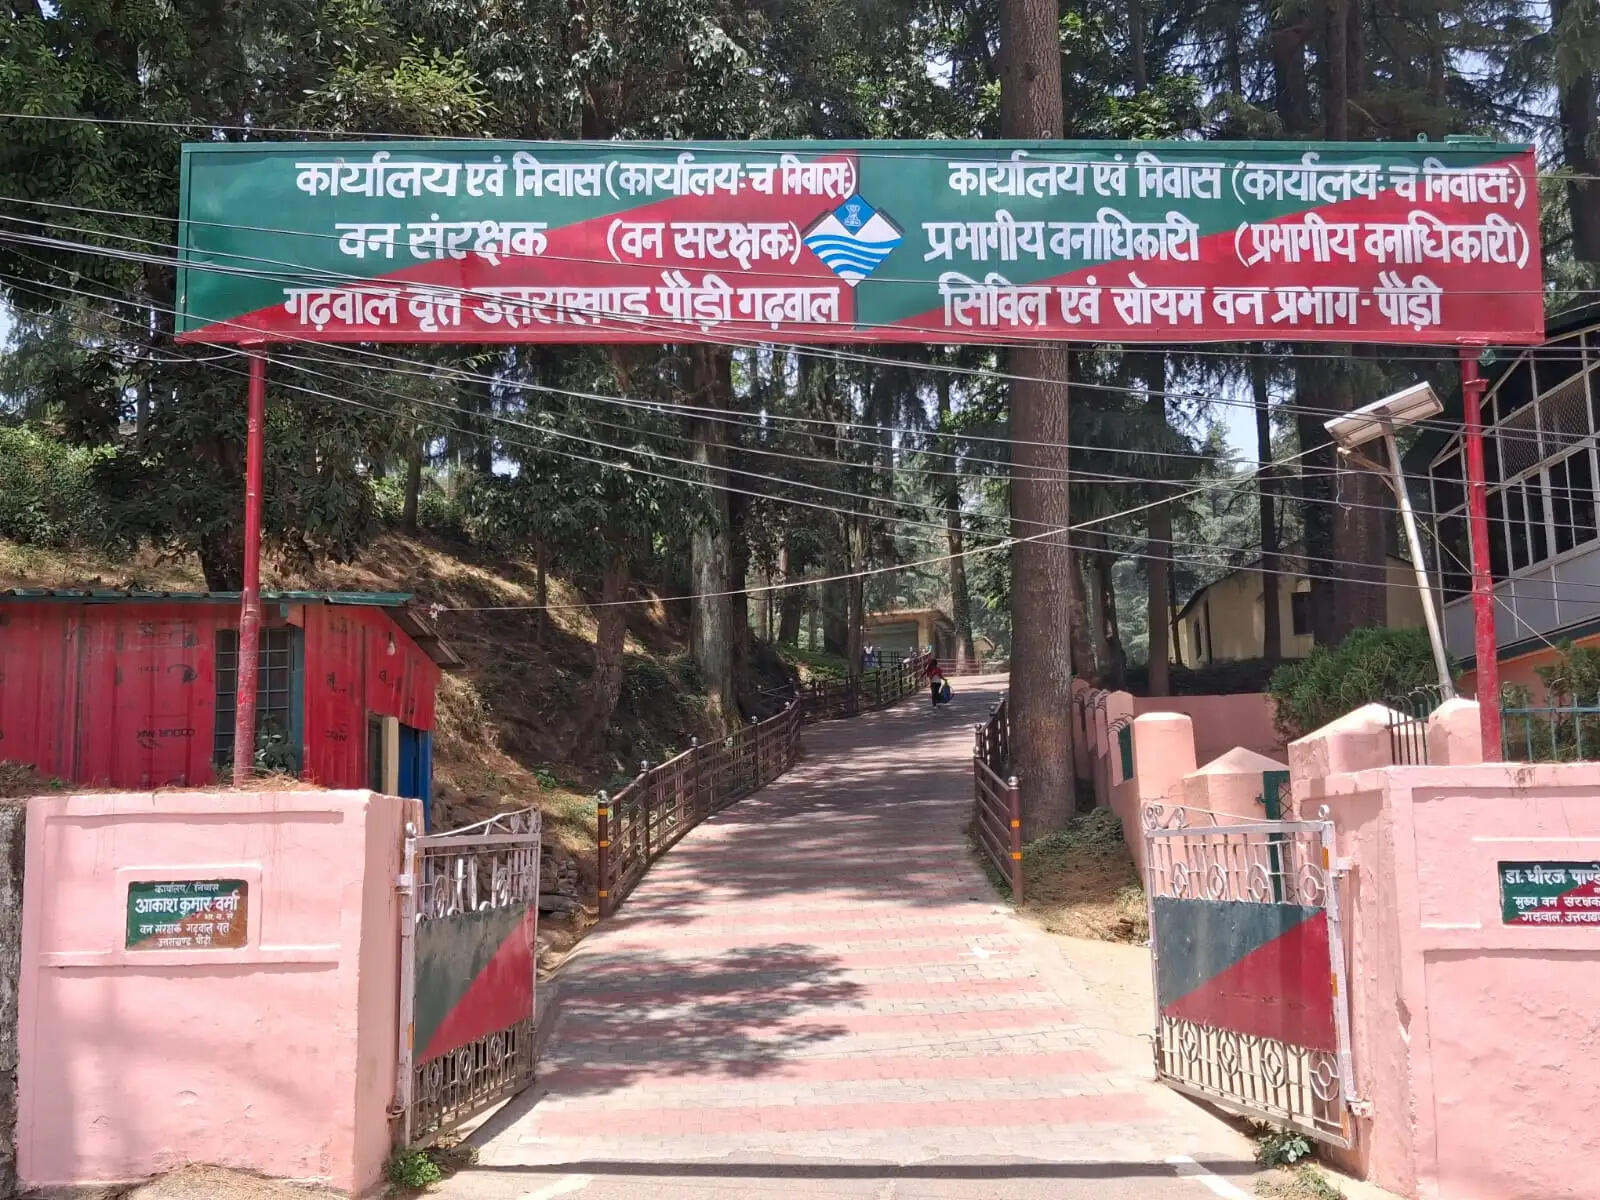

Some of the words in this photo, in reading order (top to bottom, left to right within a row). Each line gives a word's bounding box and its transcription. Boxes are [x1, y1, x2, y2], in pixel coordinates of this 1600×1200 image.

[295, 151, 462, 198] कार्यालय
[464, 155, 508, 197] एवं
[512, 151, 605, 197] निवास
[948, 150, 1088, 198] कार्यालय
[1090, 153, 1128, 196] एवं
[1134, 151, 1225, 199] निवास
[335, 223, 400, 259] वन
[406, 213, 548, 266] संरक्षक
[606, 218, 665, 263] (वन
[921, 209, 1046, 262] प्रभागीय
[1048, 206, 1200, 261] वनाधिकारी
[1234, 212, 1359, 268] (प्रभागीय
[1364, 209, 1530, 269] वनाधिकारी)
[283, 287, 400, 332] गढ़वाल
[737, 286, 840, 331] गढ़वाल
[938, 271, 1051, 326] सिविल
[1056, 275, 1101, 325] एवं
[1111, 271, 1206, 326] सोयम
[1212, 287, 1269, 325] वन
[1525, 864, 1566, 885] धीरज
[135, 897, 178, 914] आकाश
[179, 896, 212, 917] कुमार
[1511, 896, 1539, 910] मुख्य
[1540, 896, 1558, 908] वन
